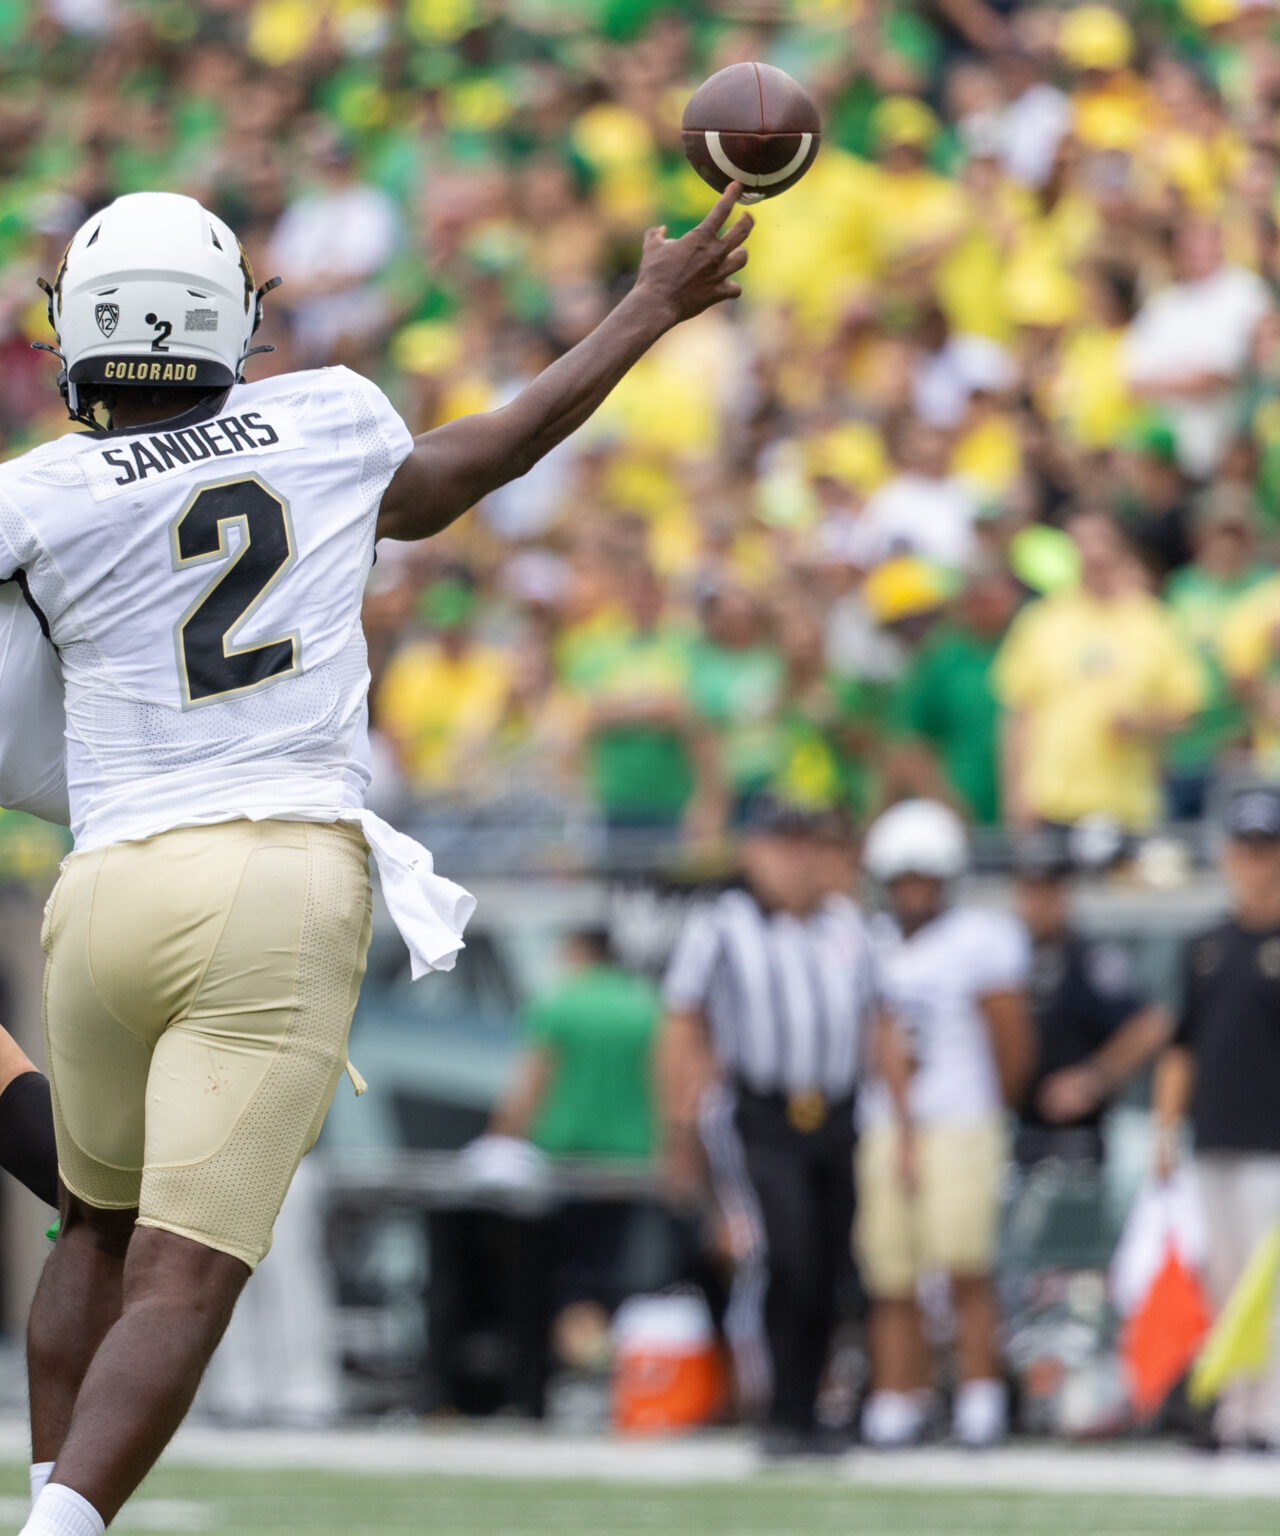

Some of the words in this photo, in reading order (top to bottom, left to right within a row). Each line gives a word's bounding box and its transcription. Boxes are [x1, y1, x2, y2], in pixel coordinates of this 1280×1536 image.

[101, 318, 113, 331] 12
[151, 321, 172, 353] 2
[104, 361, 197, 382] COLORADO
[101, 412, 280, 486] SANDERS
[168, 470, 303, 713] 2
